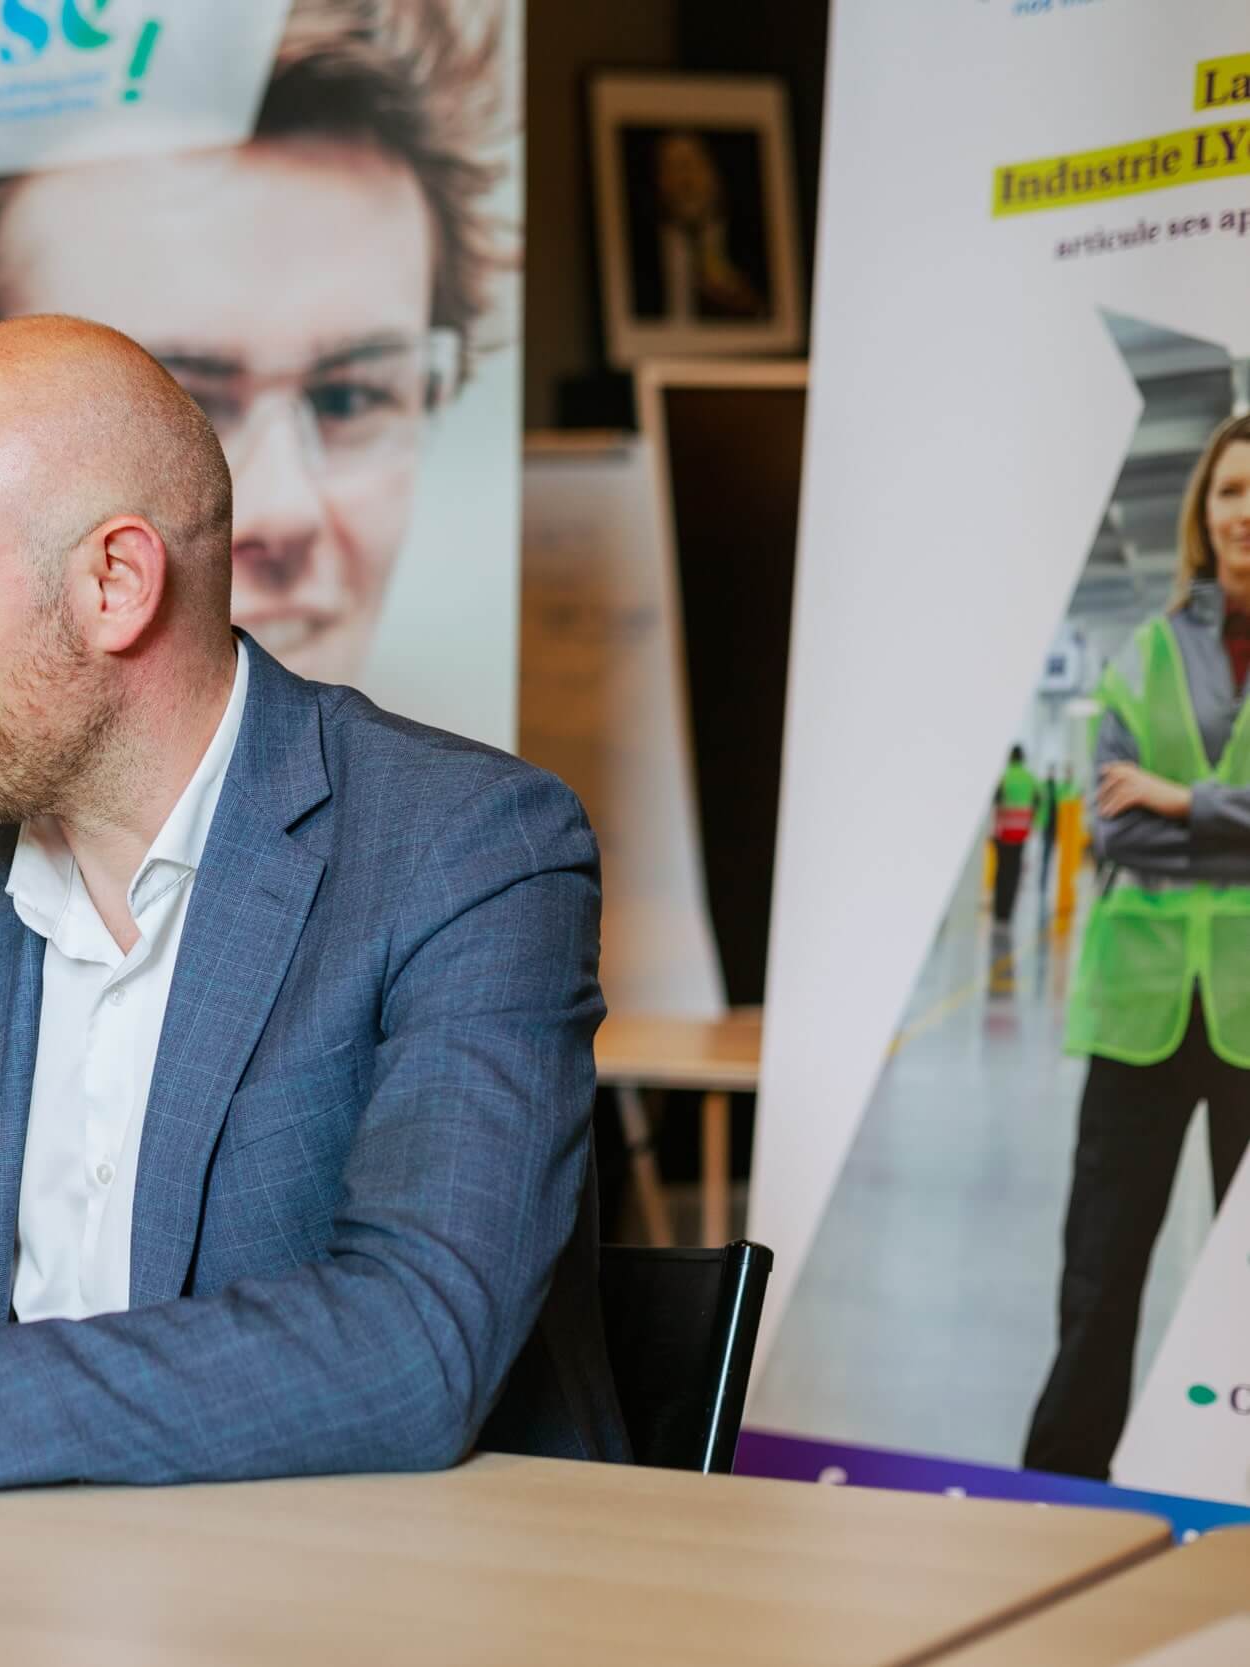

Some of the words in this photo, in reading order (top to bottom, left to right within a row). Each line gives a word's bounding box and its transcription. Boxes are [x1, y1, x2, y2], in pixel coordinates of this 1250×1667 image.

[1203, 69, 1250, 106] La
[1001, 141, 1182, 205] Industrie
[1192, 124, 1250, 169] LY
[1168, 212, 1211, 237] ses
